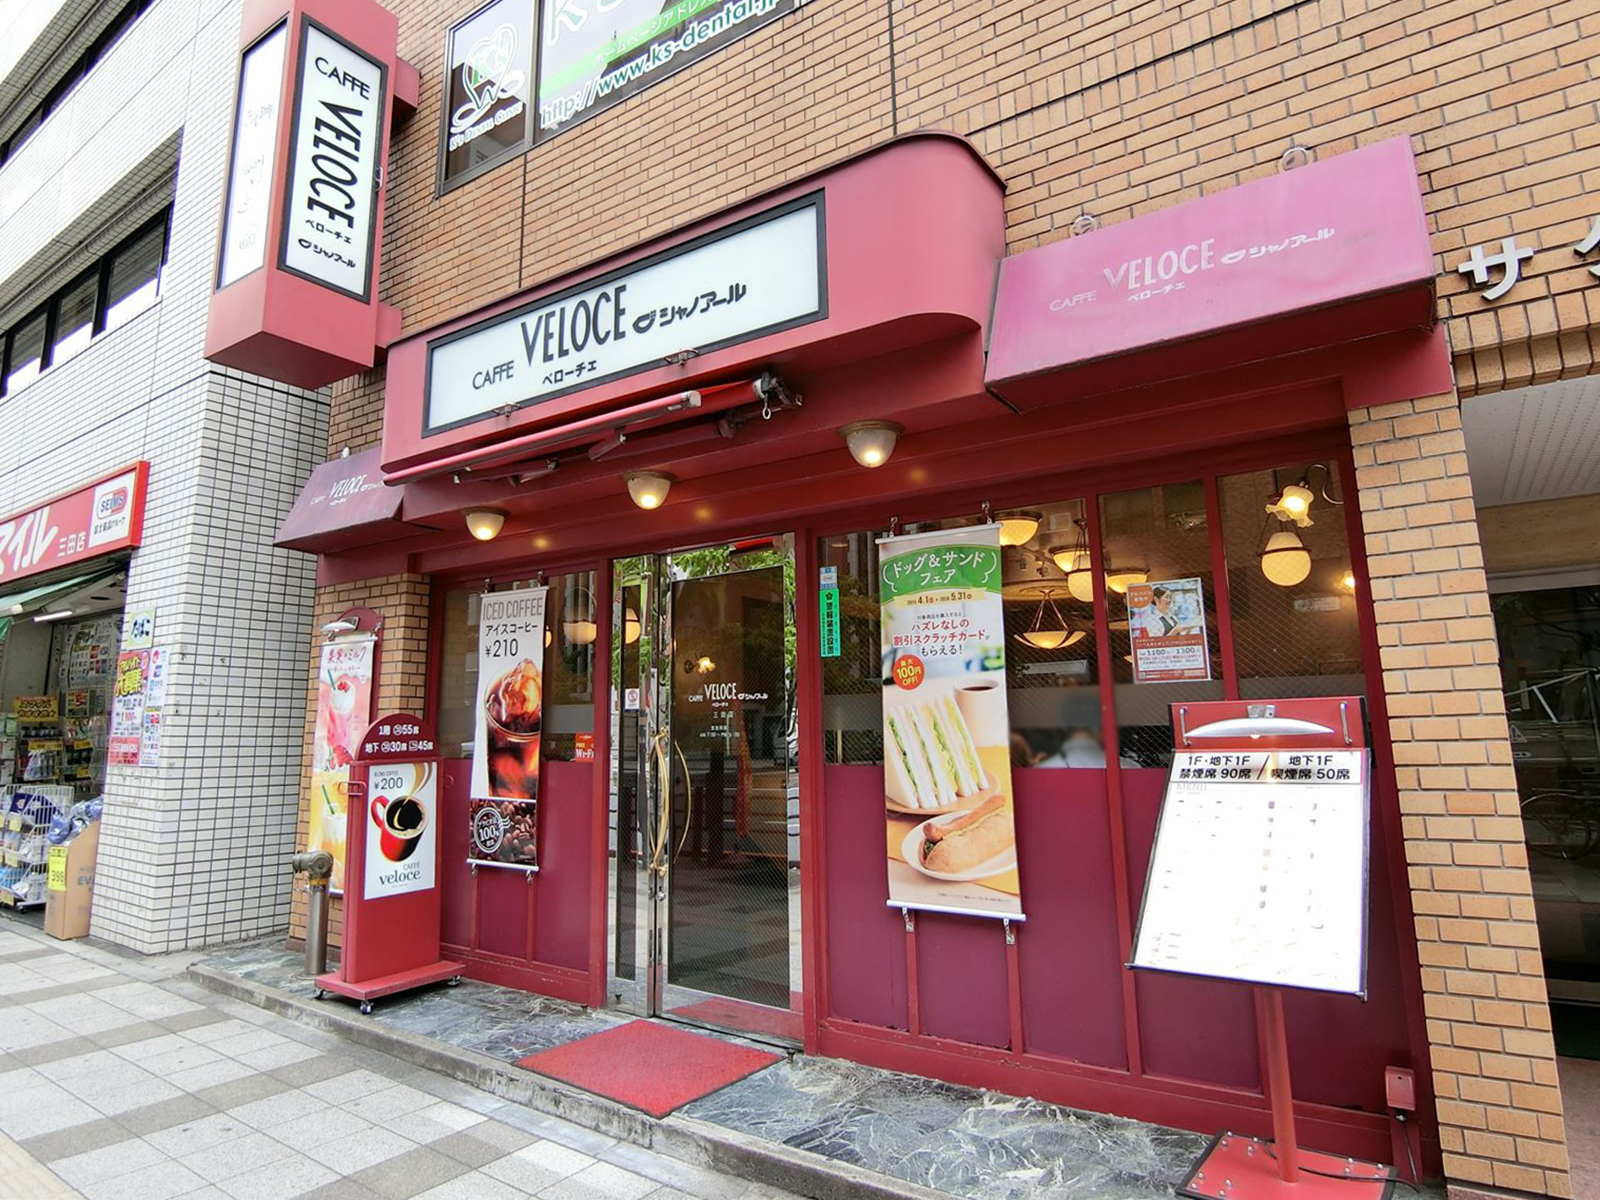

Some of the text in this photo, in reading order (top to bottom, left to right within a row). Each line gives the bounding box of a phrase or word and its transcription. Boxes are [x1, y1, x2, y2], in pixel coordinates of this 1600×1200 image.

[315, 57, 371, 100] CAFFE
[307, 100, 363, 230] VELOCE
[305, 219, 352, 245] ベローチェ
[313, 244, 356, 268] シャノアール
[1050, 227, 1335, 312] CAFFE VELOCE シャノアール
[1127, 281, 1187, 303] ベローチェ
[472, 281, 747, 390] CAFFE VELOCE シャノアール
[542, 359, 598, 385] ベローチェ
[893, 550, 986, 579] ドッグ&サンド
[921, 569, 956, 586] フェア
[483, 598, 543, 620] ICED COFFEE
[486, 622, 538, 637] アイスコーヒー
[911, 619, 969, 631] ハズレなしの
[485, 638, 518, 657] ¥210
[897, 666, 921, 679] 100円
[704, 683, 737, 700] VELOCE
[374, 777, 403, 790] ¥200
[1179, 768, 1350, 780] 禁煙席 90席 喫煙席 50席
[379, 869, 421, 885] veloce
